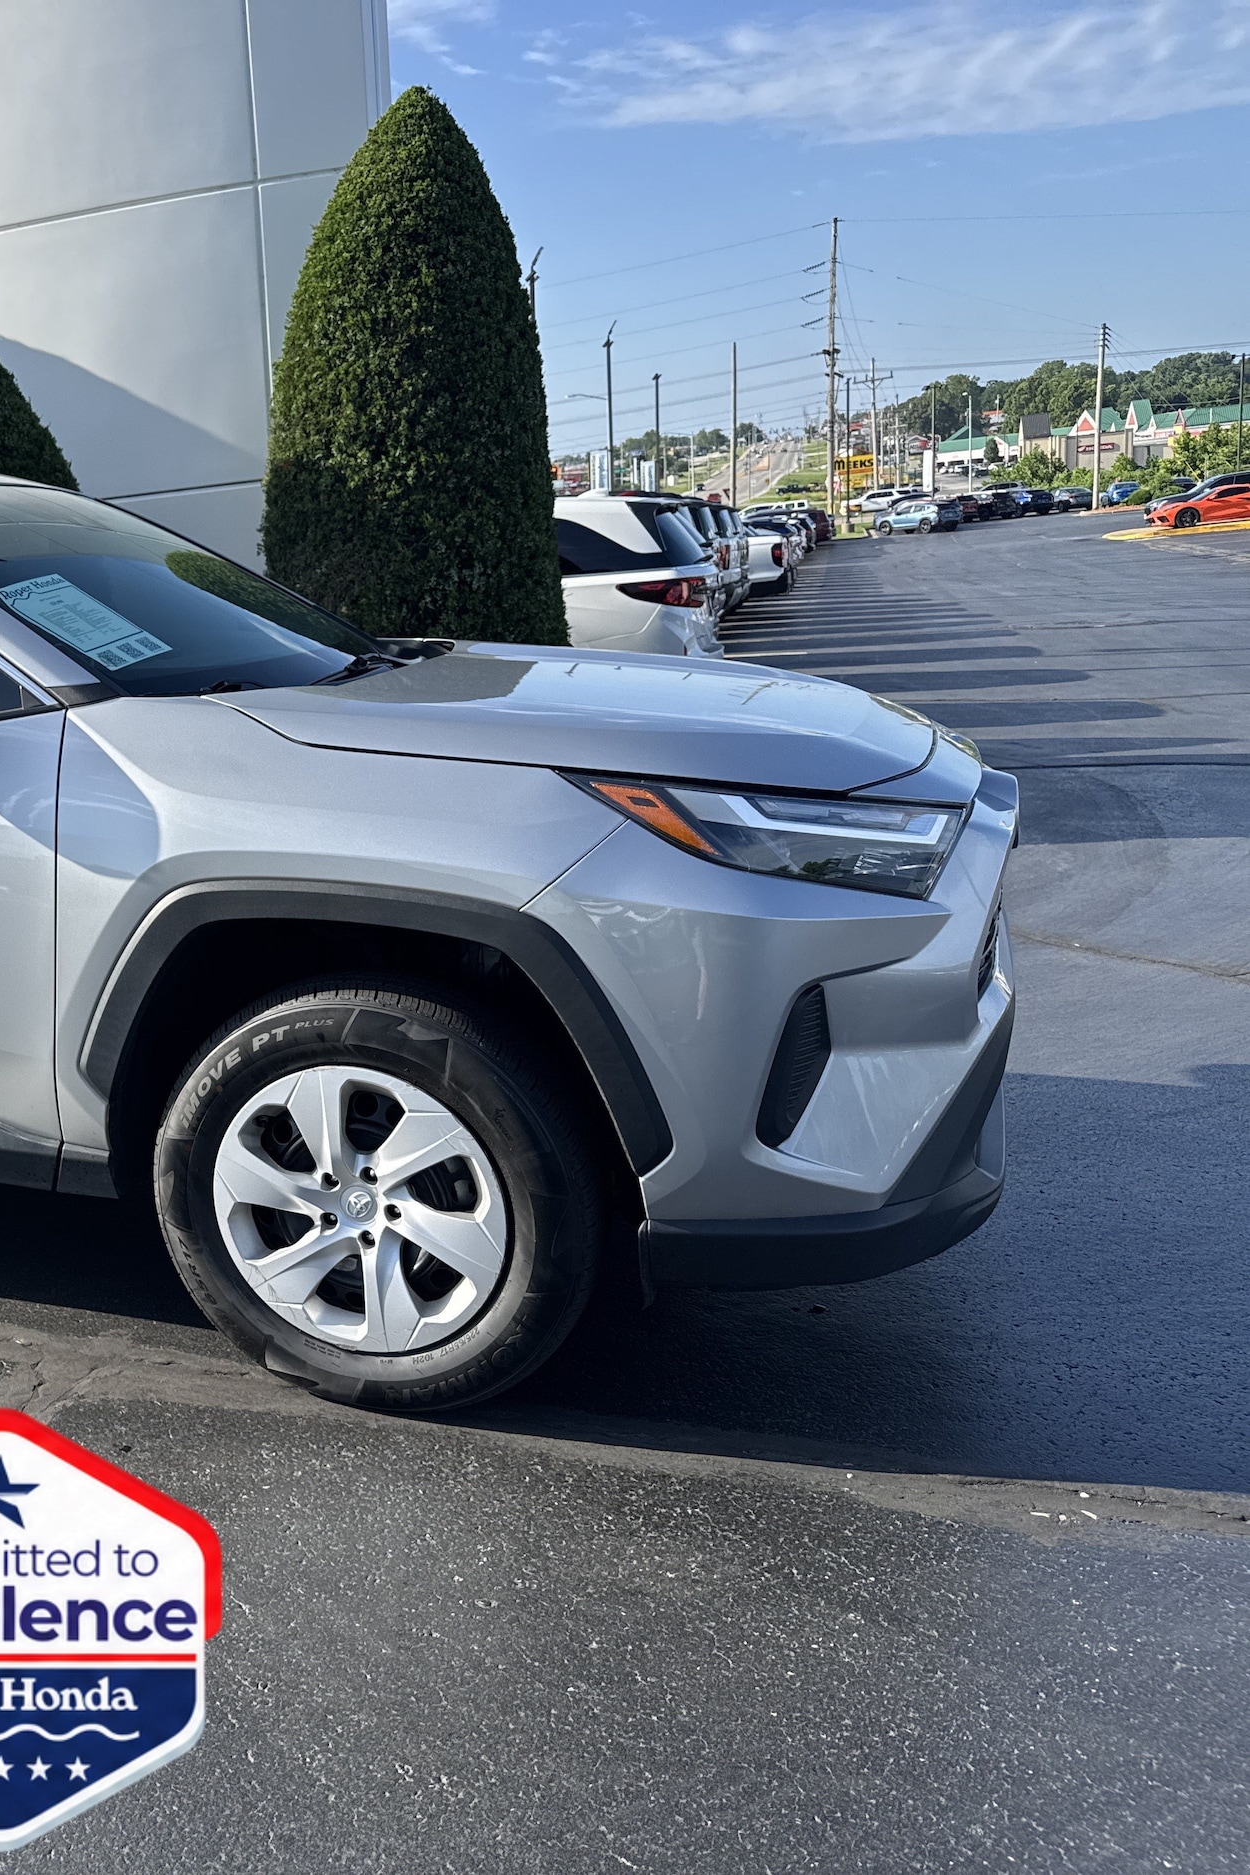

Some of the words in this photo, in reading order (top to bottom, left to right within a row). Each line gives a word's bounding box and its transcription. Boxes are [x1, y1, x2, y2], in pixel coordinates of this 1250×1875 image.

[0, 585, 33, 600] Roper
[30, 576, 66, 590] Honda
[252, 1025, 291, 1052] PT
[295, 1018, 335, 1030] PLUS
